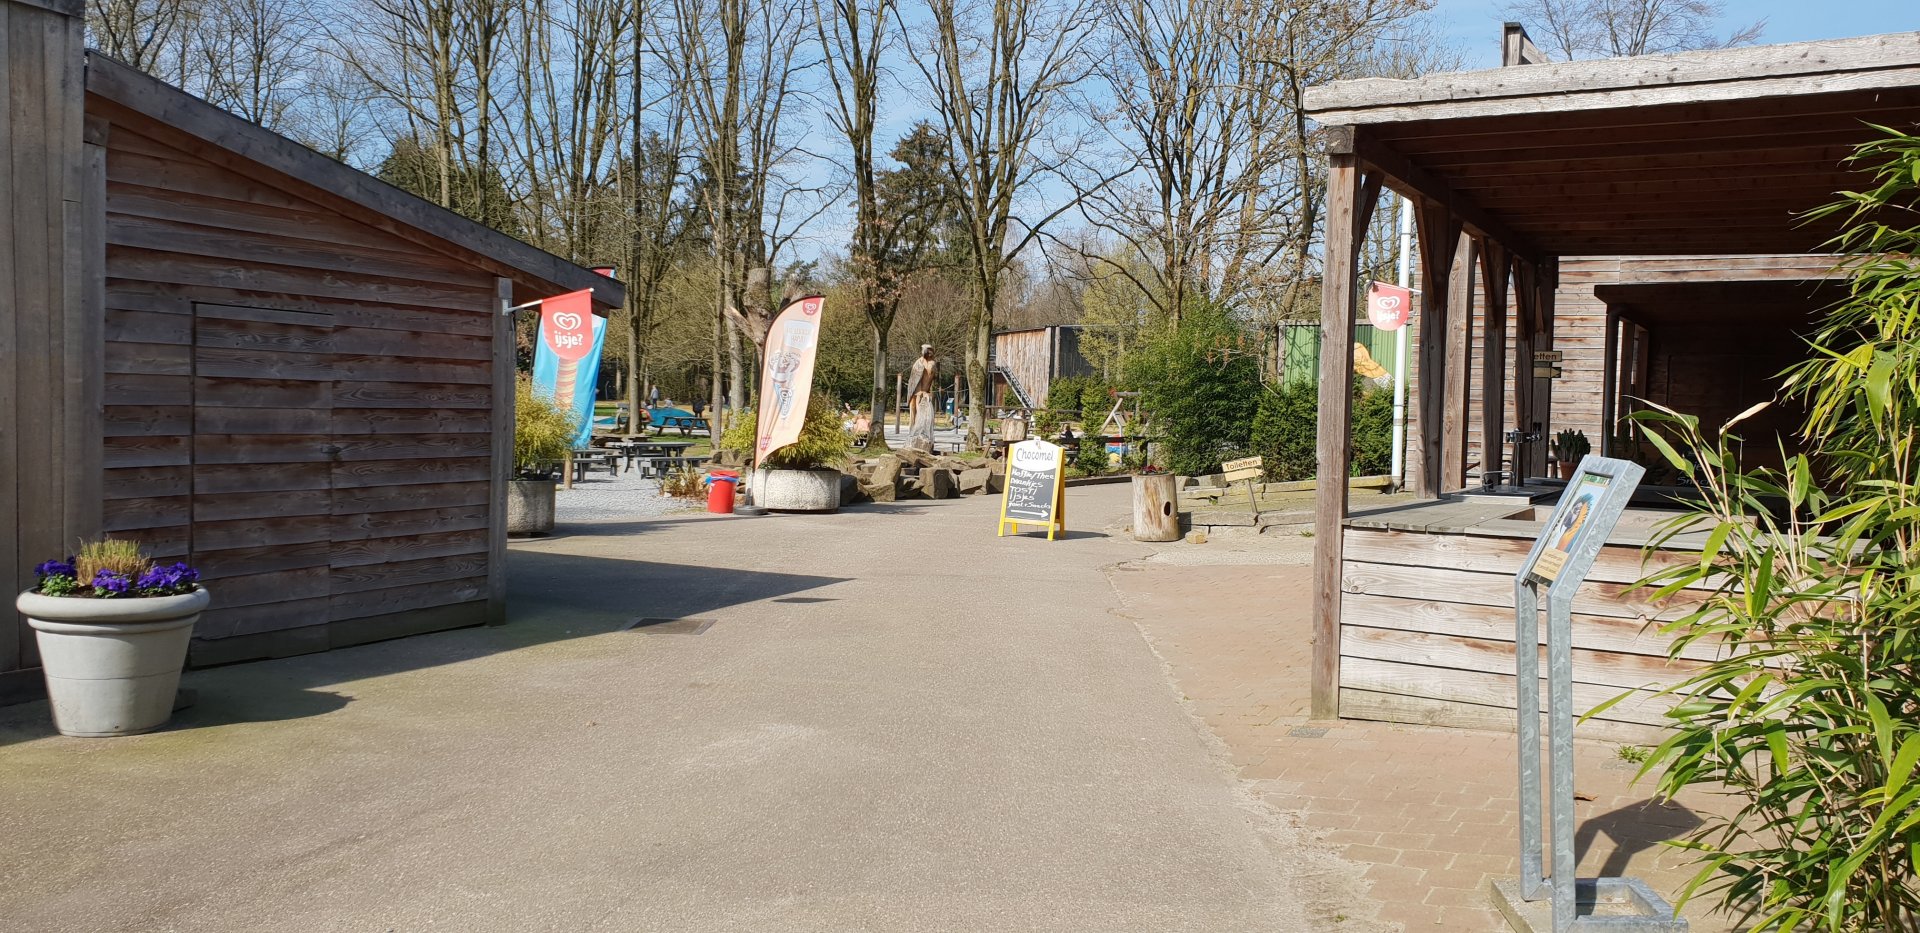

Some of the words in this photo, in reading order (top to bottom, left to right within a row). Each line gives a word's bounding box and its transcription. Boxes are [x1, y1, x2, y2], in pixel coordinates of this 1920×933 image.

[554, 330, 583, 349] ijsje?
[1016, 448, 1054, 461] Chocomel
[1225, 459, 1258, 470] Toiletten
